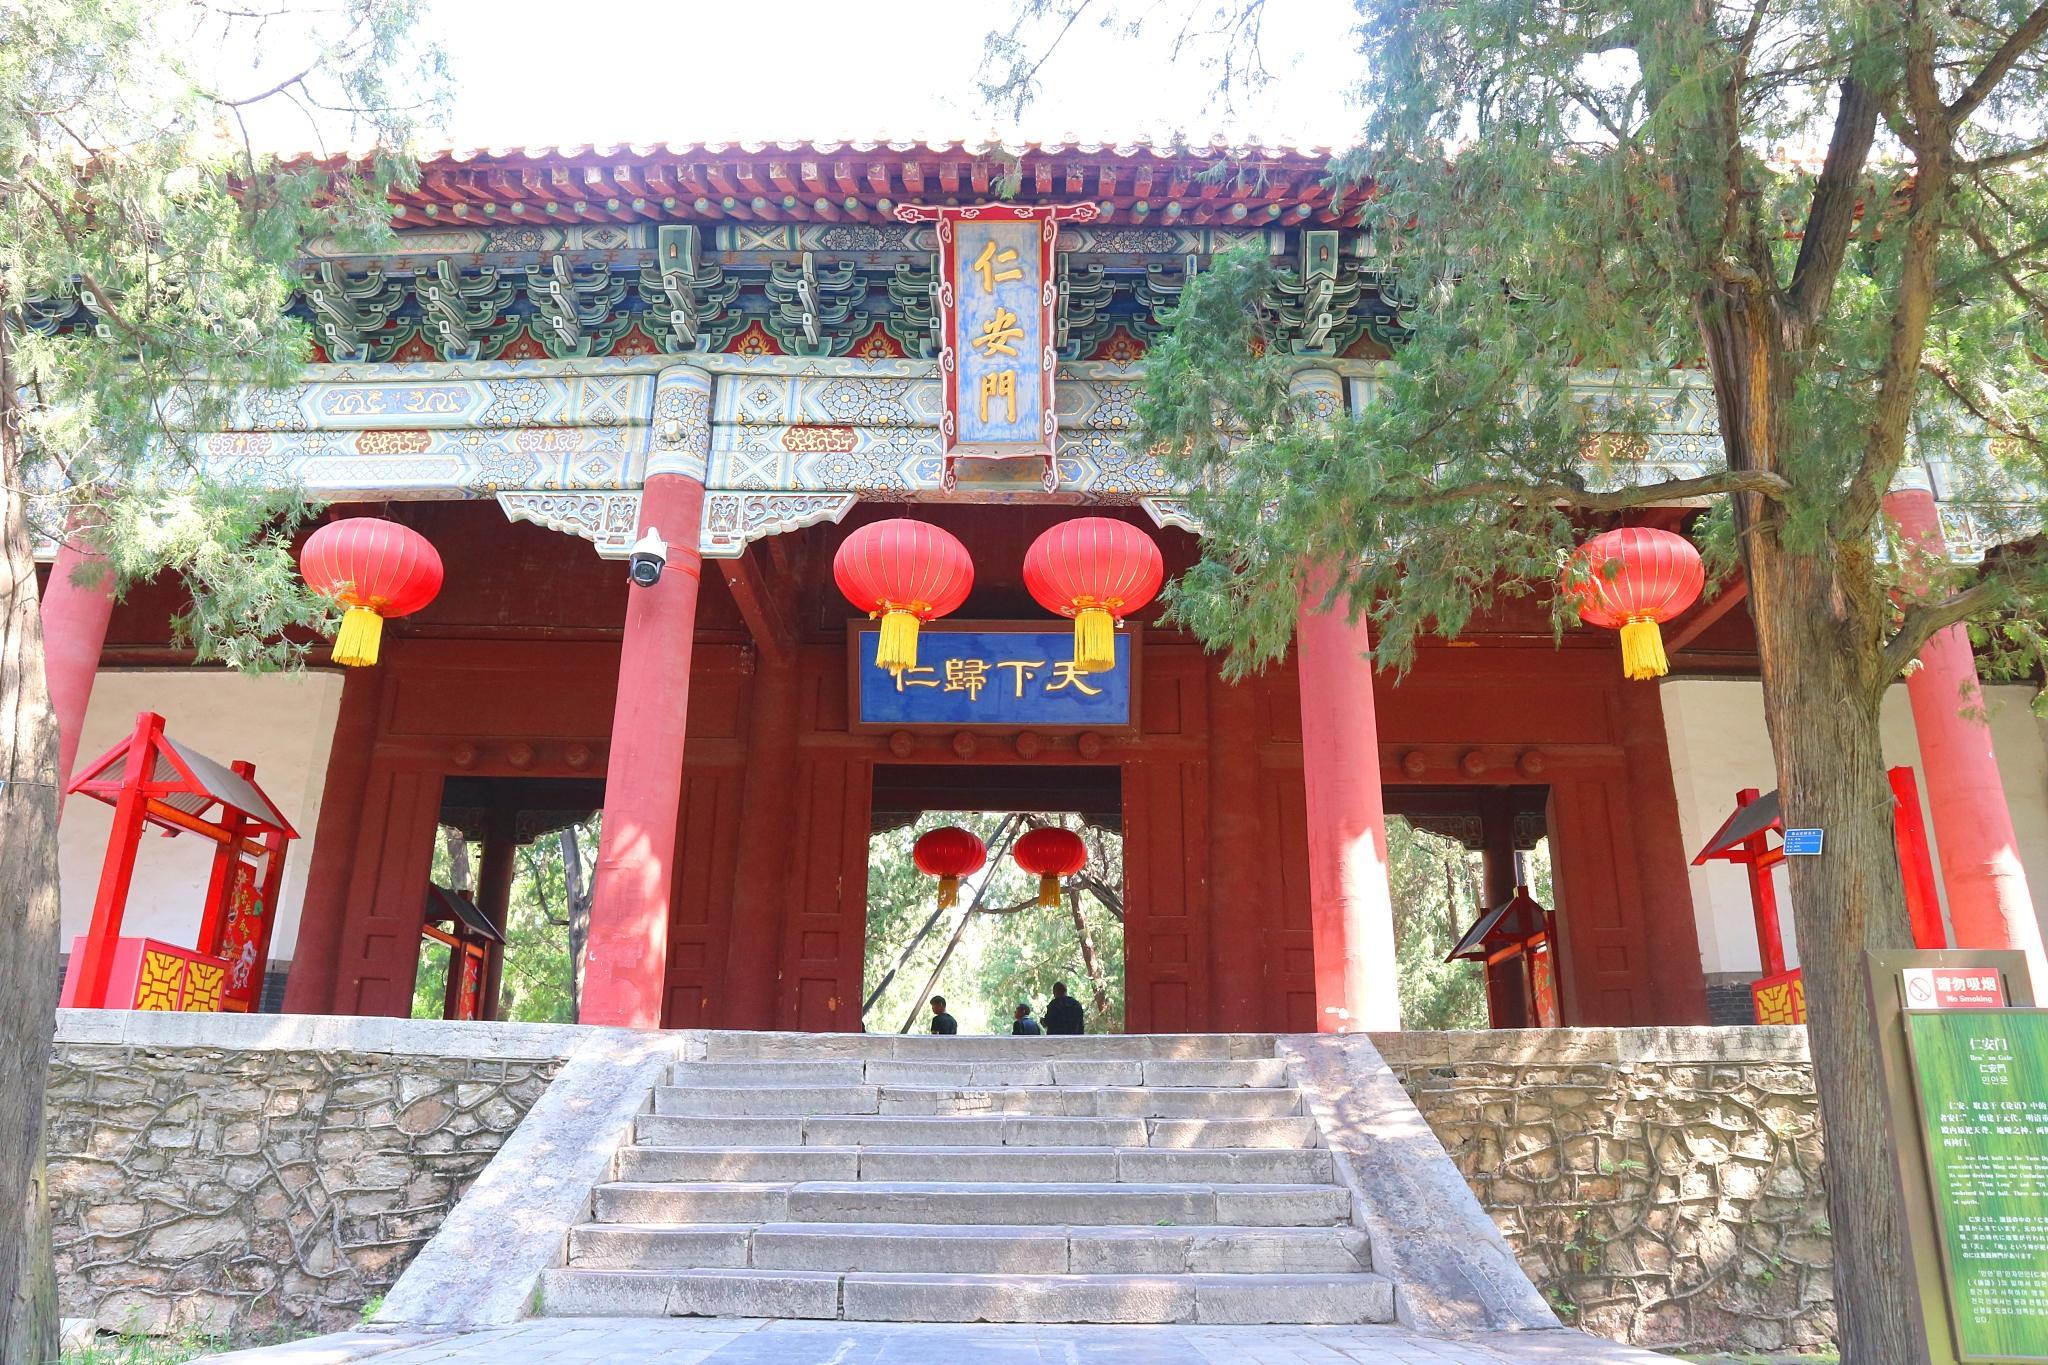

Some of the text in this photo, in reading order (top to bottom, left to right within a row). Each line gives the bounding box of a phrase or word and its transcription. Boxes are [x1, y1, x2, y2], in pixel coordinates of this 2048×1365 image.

[972, 240, 1025, 425] 仁安門
[1936, 976, 1997, 992] 请勿吸烟
[1959, 995, 1993, 1003] Smoking
[1970, 1038, 2008, 1051] 仁安门
